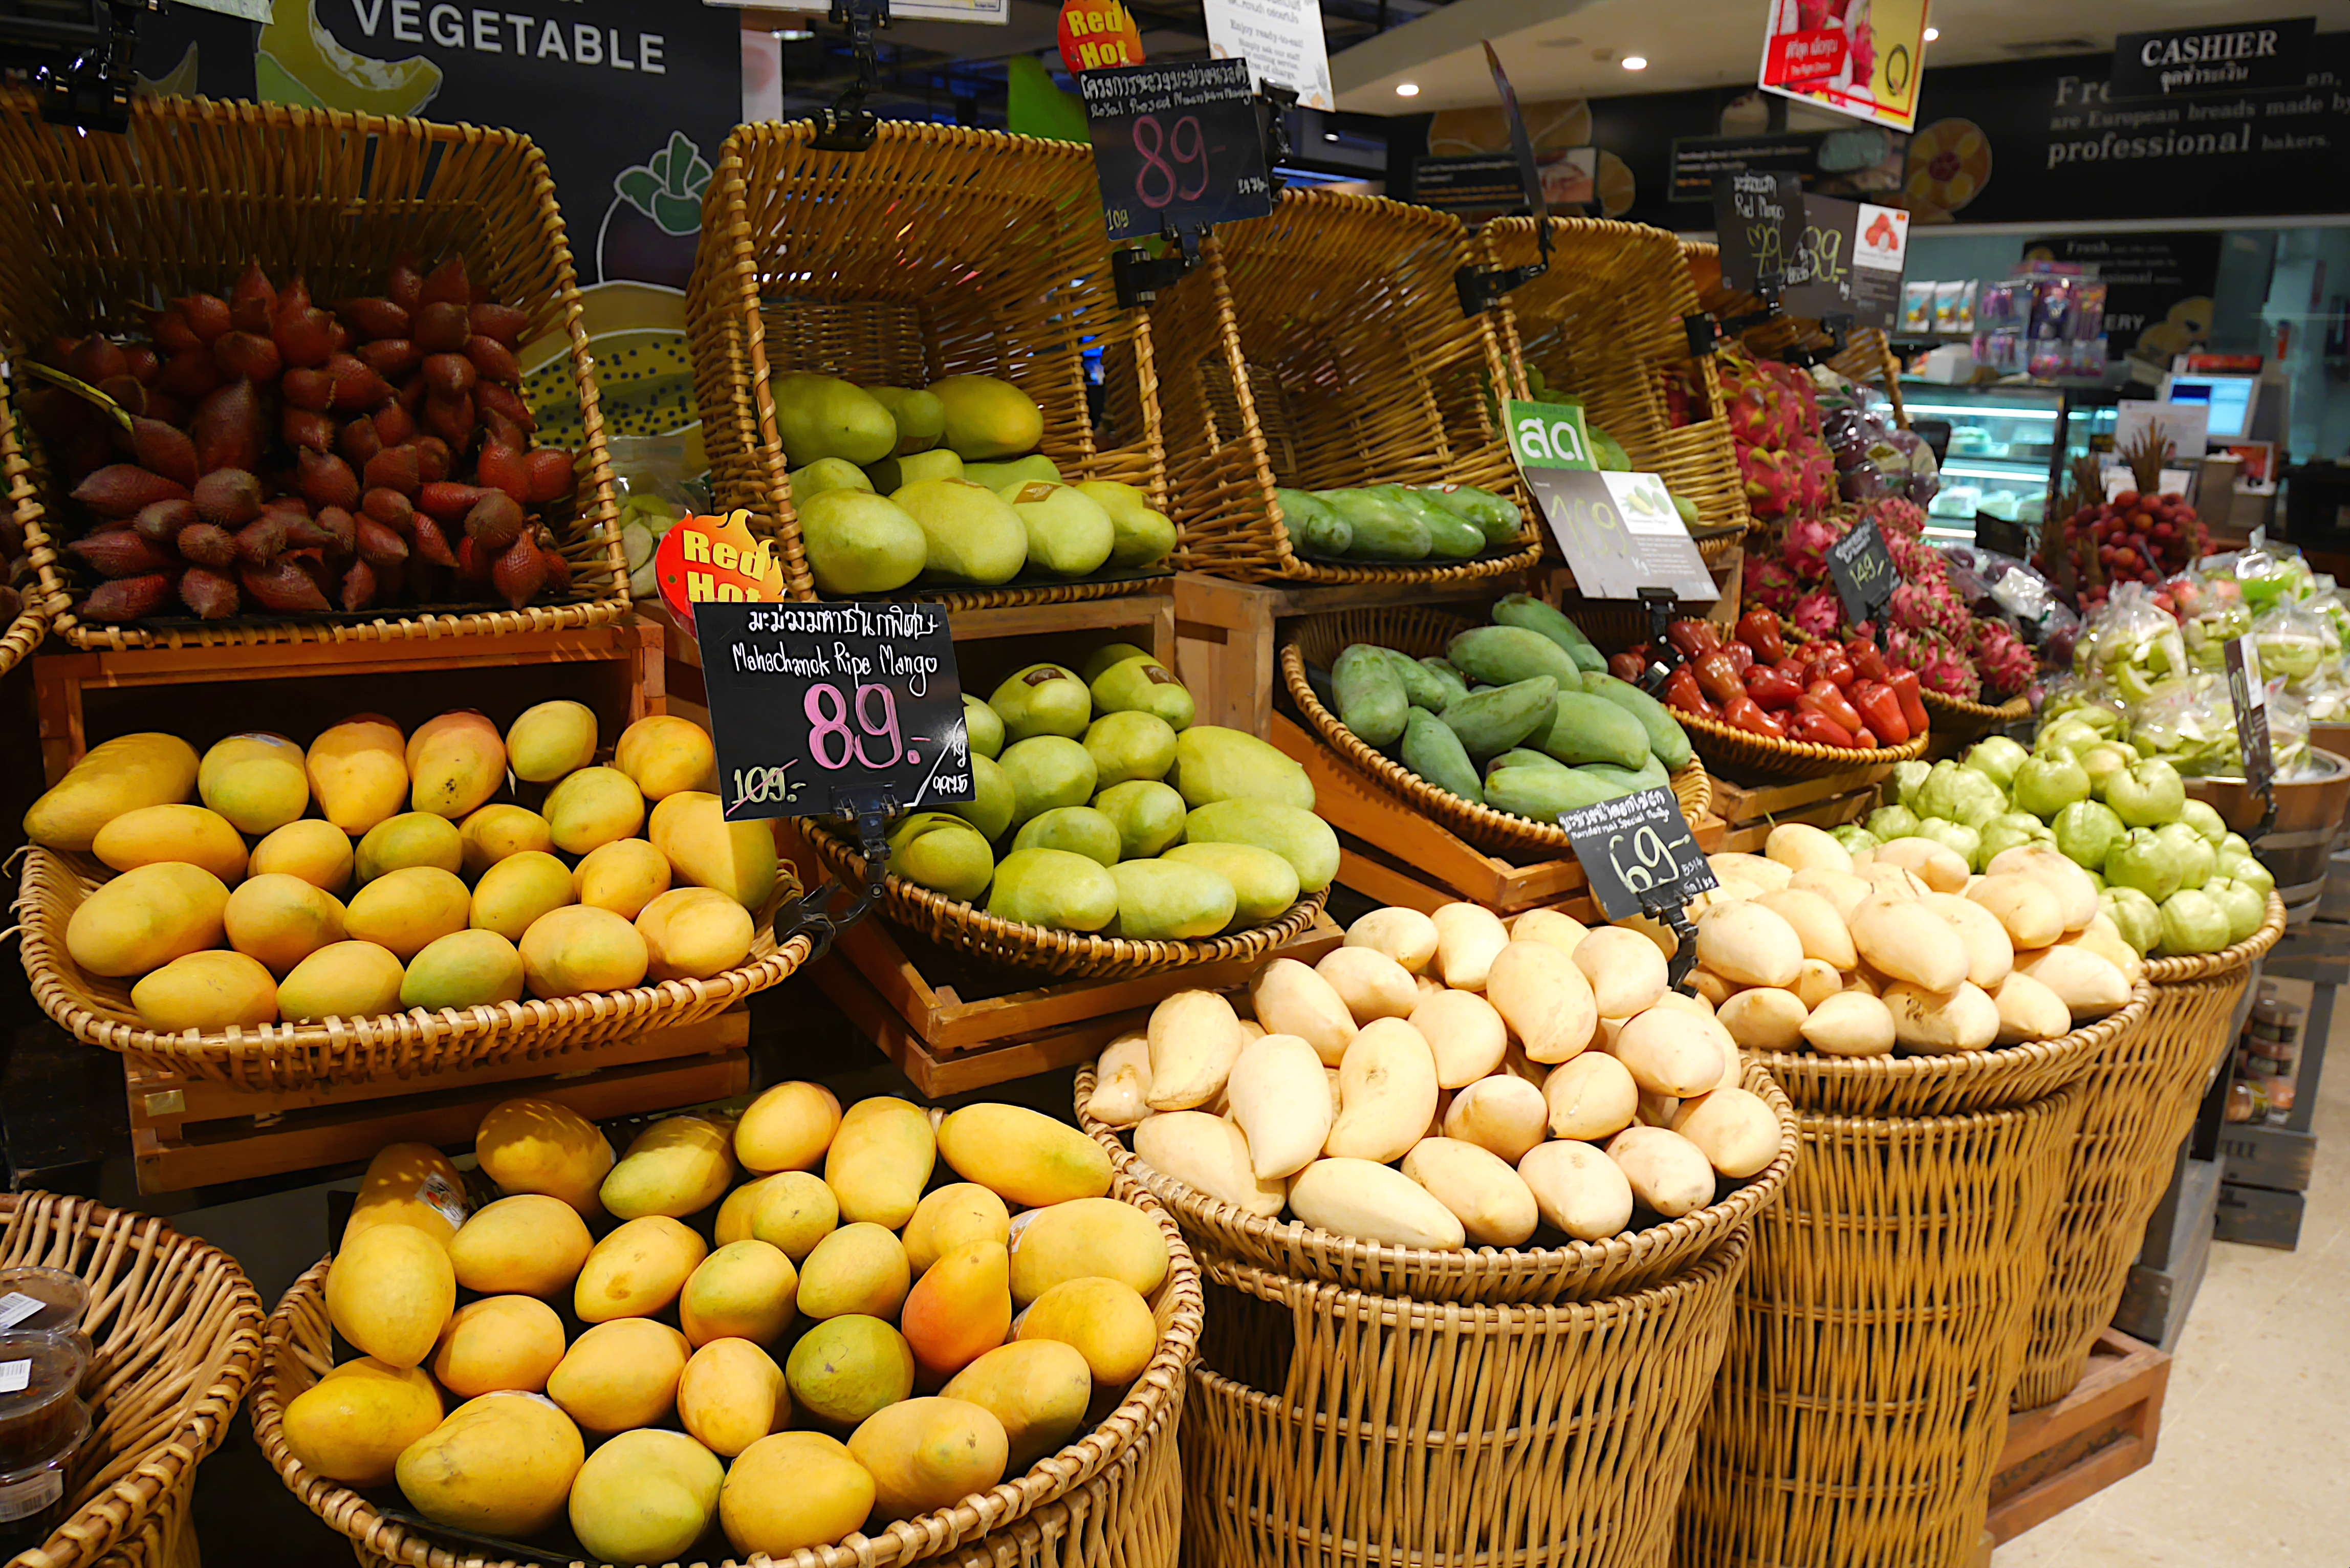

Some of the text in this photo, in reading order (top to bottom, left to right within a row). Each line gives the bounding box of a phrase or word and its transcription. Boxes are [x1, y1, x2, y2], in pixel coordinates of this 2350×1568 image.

[351, 0, 666, 74] VEGETABLE
[1065, 6, 1124, 38] Red
[1078, 39, 1127, 70] Hot
[2141, 29, 2279, 68] CASHIER
[2087, 104, 2181, 130] European
[2265, 93, 2324, 117] made
[2047, 123, 2252, 170] professional
[1517, 417, 1585, 462] สด
[682, 529, 768, 582] Red
[687, 571, 763, 603] Hot
[732, 640, 938, 697] Mahachanok Ripe Mango
